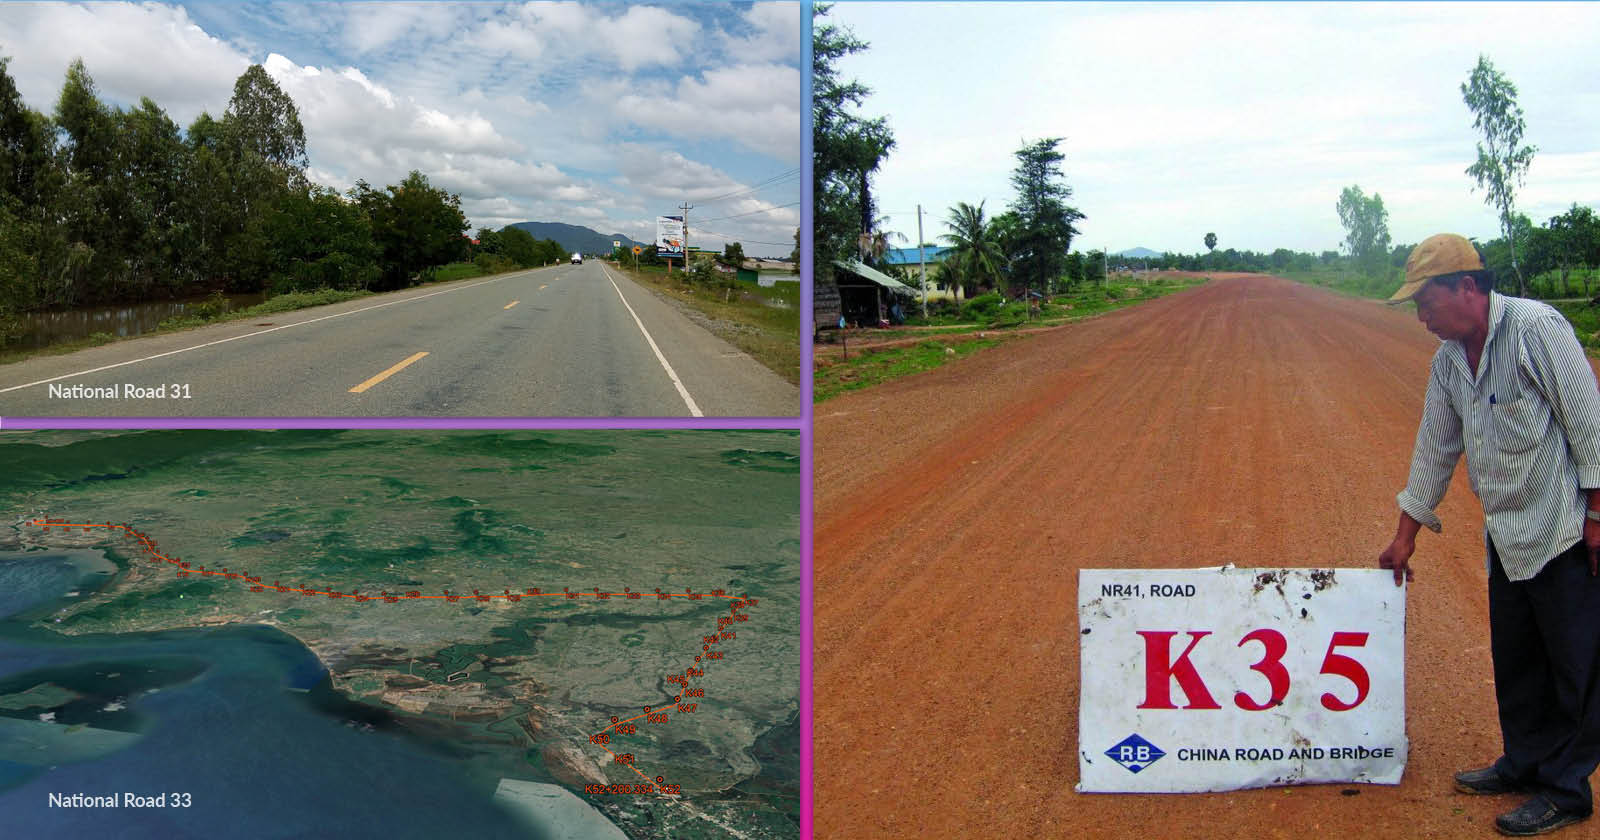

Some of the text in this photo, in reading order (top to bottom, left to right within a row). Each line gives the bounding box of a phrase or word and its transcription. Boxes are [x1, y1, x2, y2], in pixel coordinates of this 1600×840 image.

[1101, 584, 1196, 599] NR41, ROAD
[1177, 747, 1395, 761] CHINA ROAD AND BRIDGE
